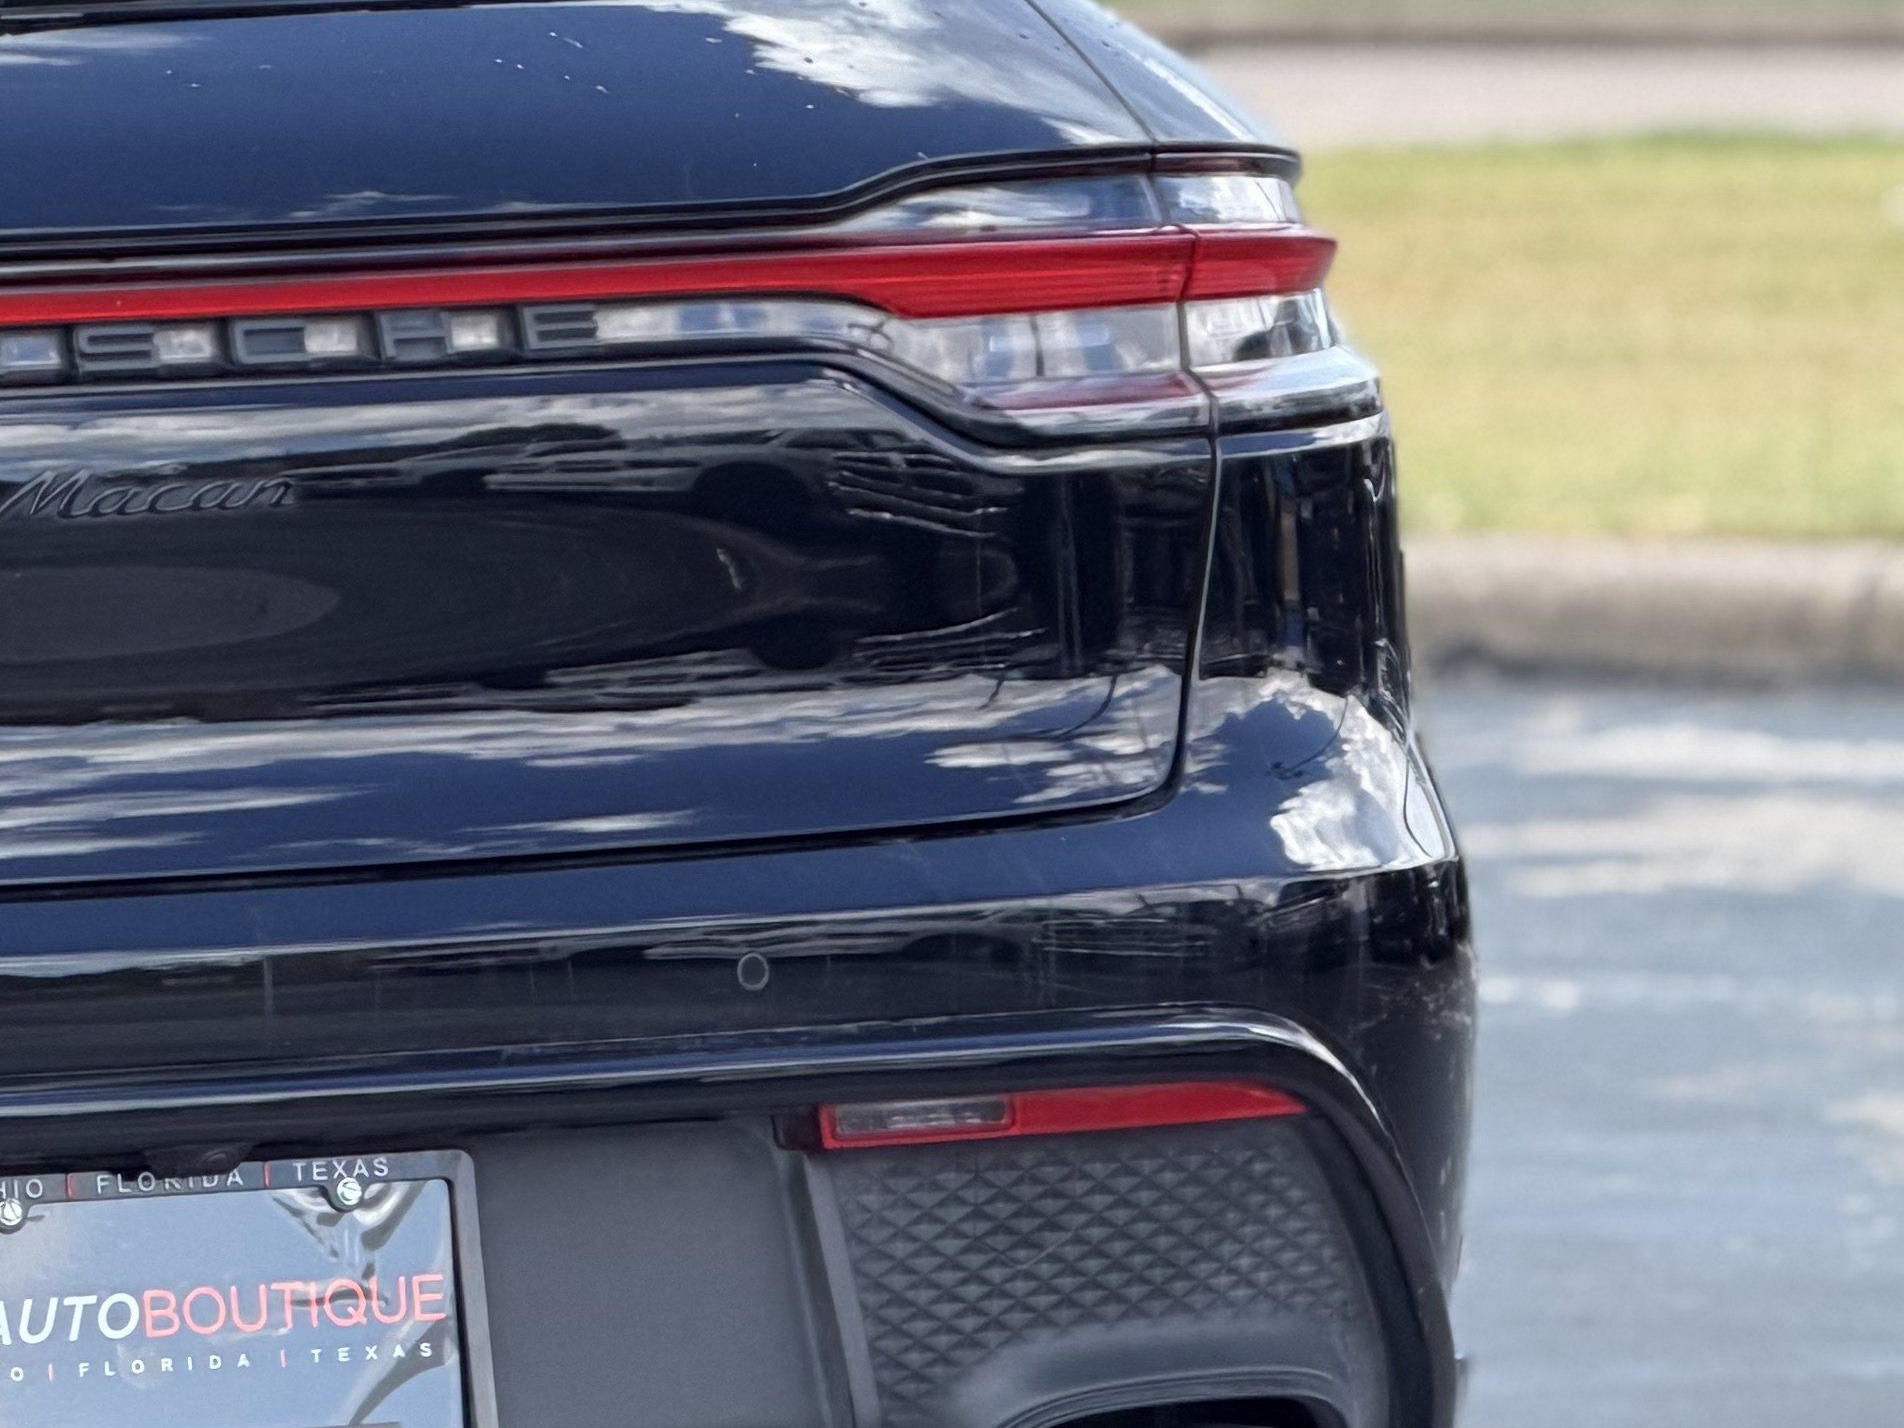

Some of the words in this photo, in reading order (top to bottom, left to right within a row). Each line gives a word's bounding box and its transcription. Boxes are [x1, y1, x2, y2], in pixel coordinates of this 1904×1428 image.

[293, 1157, 390, 1182] TEXAS
[78, 1353, 251, 1378] FLORIDA
[310, 1342, 434, 1364] TEXAS
